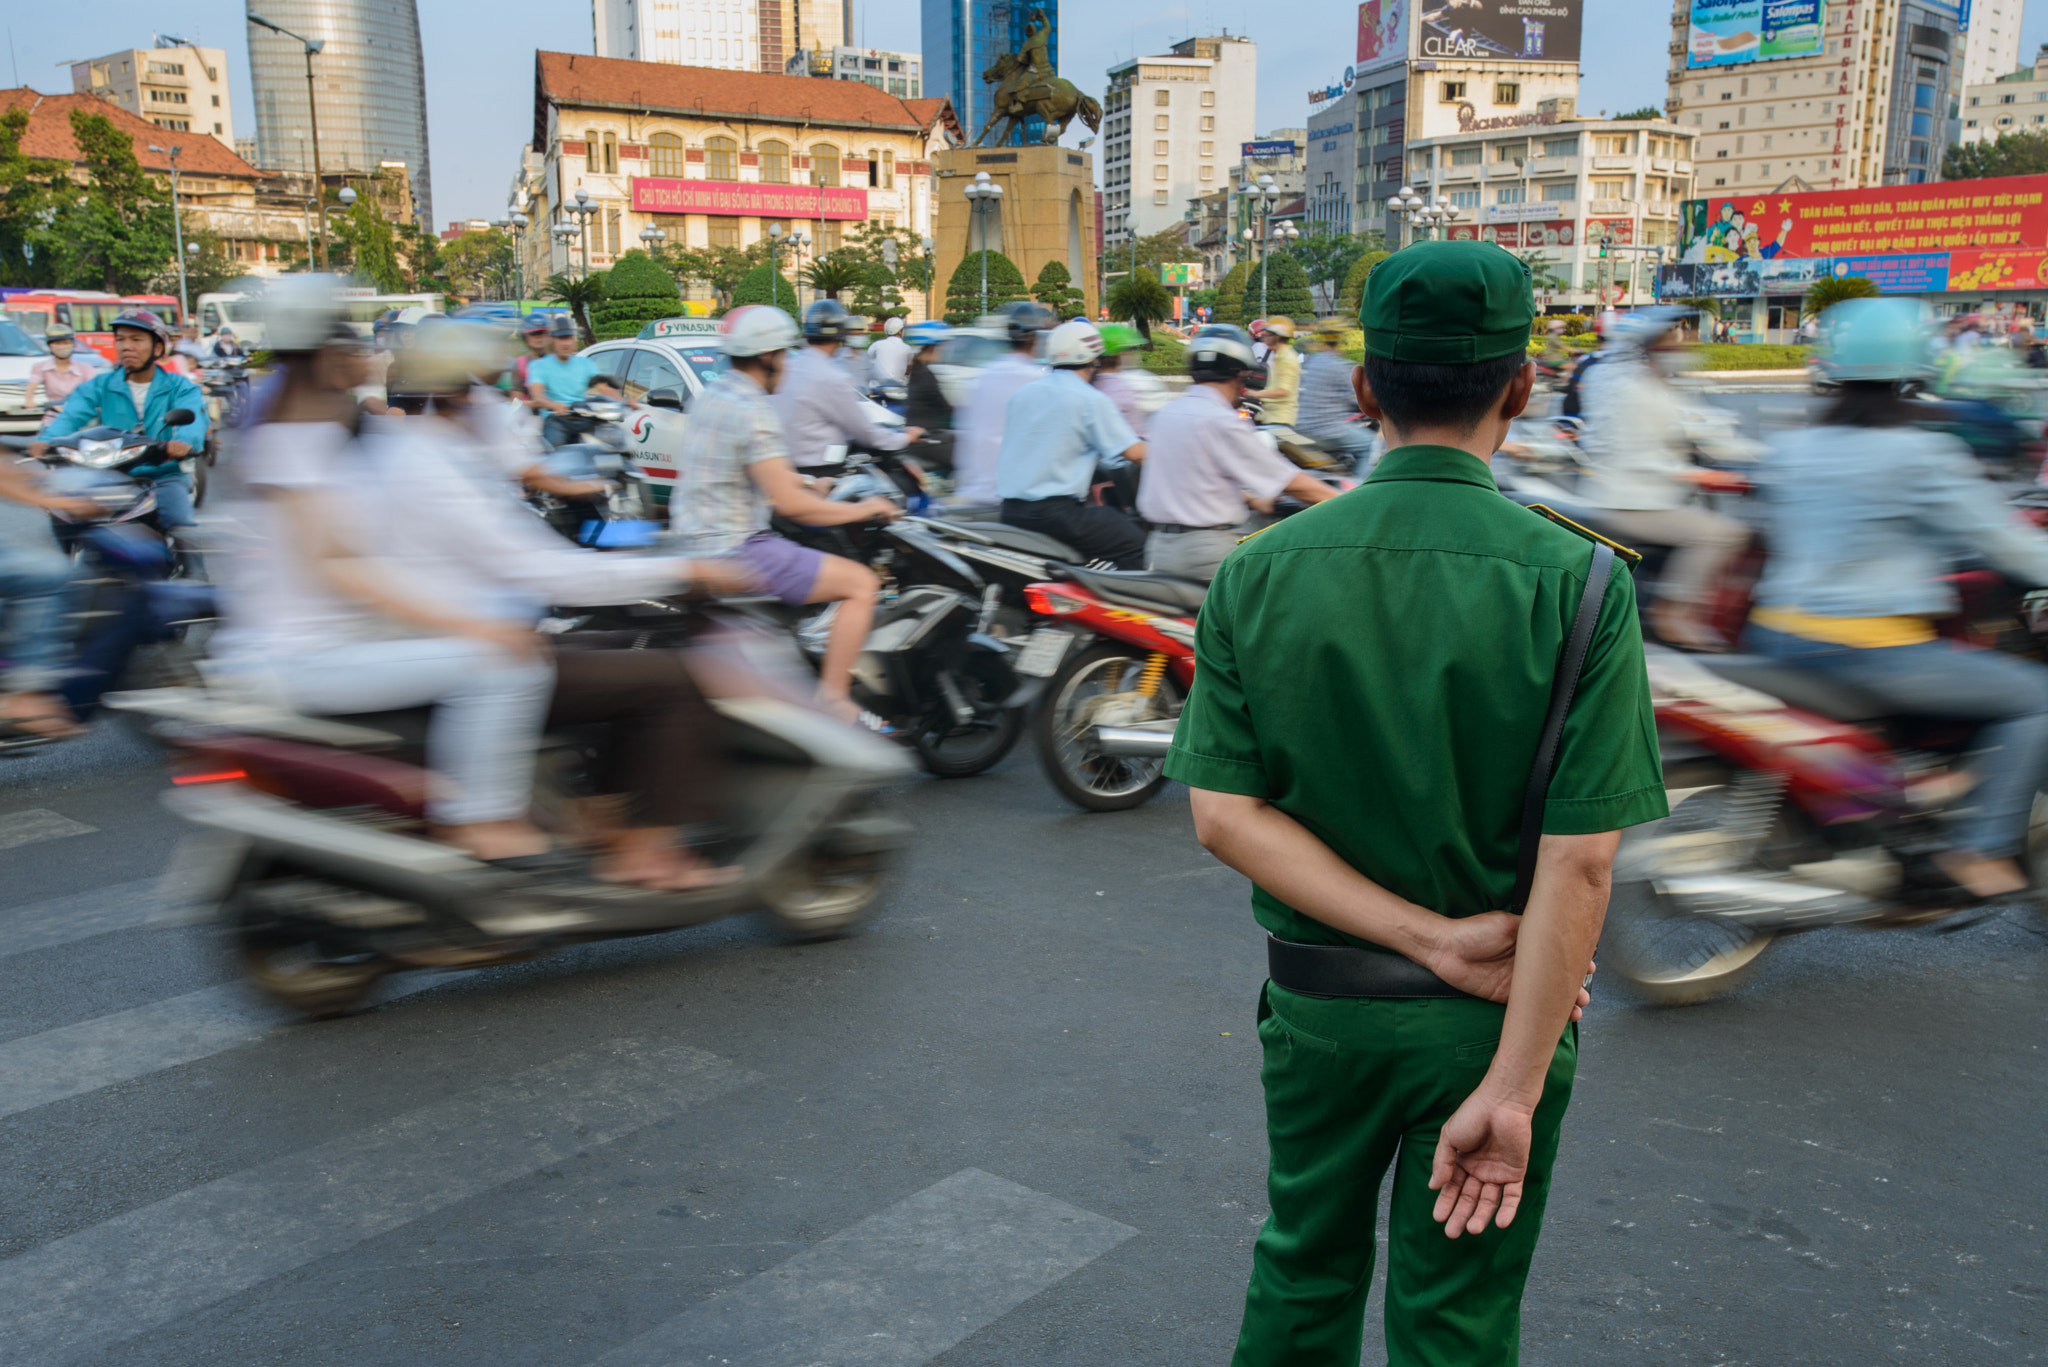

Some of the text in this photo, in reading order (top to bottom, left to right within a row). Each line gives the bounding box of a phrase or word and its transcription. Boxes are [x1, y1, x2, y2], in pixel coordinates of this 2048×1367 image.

[1517, 6, 1532, 15] CAO
[1533, 7, 1556, 16] PHONG
[1696, 0, 1756, 9] Salonpa
[1766, 3, 1815, 19] Salonpas
[1424, 36, 1477, 56] CLEAR
[640, 182, 654, 205] CHỦ
[655, 188, 671, 208] TỊCH
[672, 183, 682, 206] HỒ
[683, 186, 694, 206] CHÍ
[695, 190, 711, 207] MINH
[720, 191, 731, 211] ĐẠI
[732, 186, 750, 209] SỐNG
[751, 190, 762, 209] MÃI
[763, 194, 785, 210] TRONG
[785, 193, 794, 213] SỰ
[795, 192, 817, 214] NGHIỆP
[832, 194, 853, 213] CHÚNG
[1800, 192, 2042, 218] TOÀN ĐẢNG, TOÀN DÂN, TOÀN QUÂN PHÁT HUY SỨC MẠNH
[1813, 224, 1828, 238] ĐẠI
[1829, 221, 1852, 235] ĐOÀN
[1874, 217, 1903, 233] QUYẾT
[1905, 217, 1924, 230] TÂM
[1926, 216, 1949, 231] THỰC
[1950, 213, 1972, 230] HIỆN
[1974, 210, 2004, 226] THẮNG
[2005, 211, 2022, 228] LỢI
[1830, 237, 1858, 253] QUYẾT
[1860, 238, 1875, 253] ĐẠI
[1892, 234, 1916, 248] ĐẢNG
[1918, 233, 1942, 247] TOÀN
[1943, 231, 1967, 248] QUỐC
